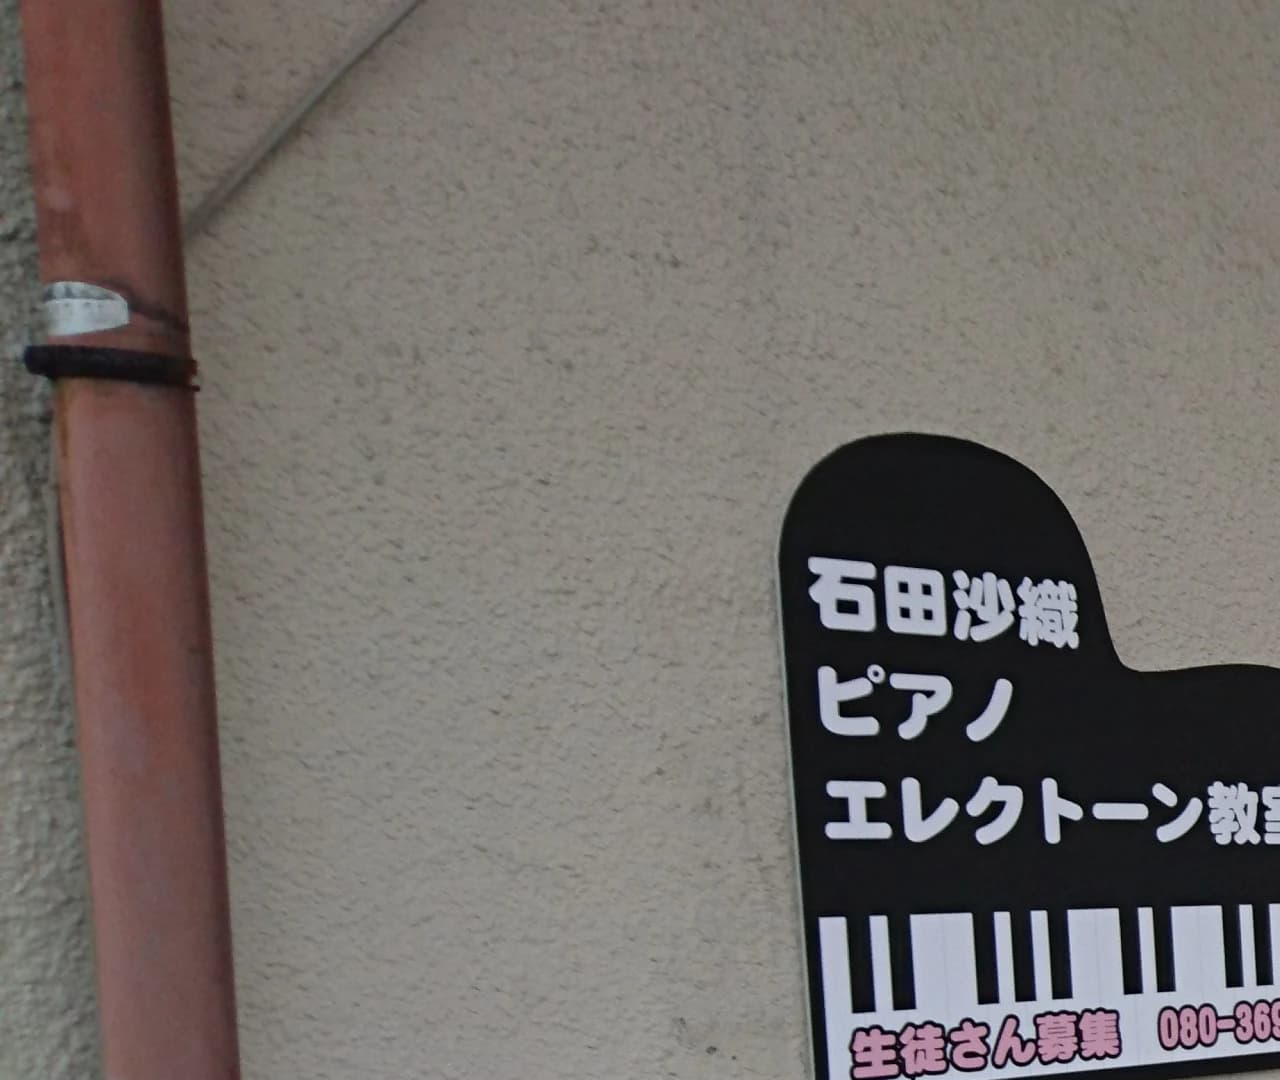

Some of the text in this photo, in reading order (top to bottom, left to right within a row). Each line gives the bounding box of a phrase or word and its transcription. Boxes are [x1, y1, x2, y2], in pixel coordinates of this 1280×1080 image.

[807, 556, 1080, 648] 石田沙織
[817, 664, 1014, 742] ピアノ
